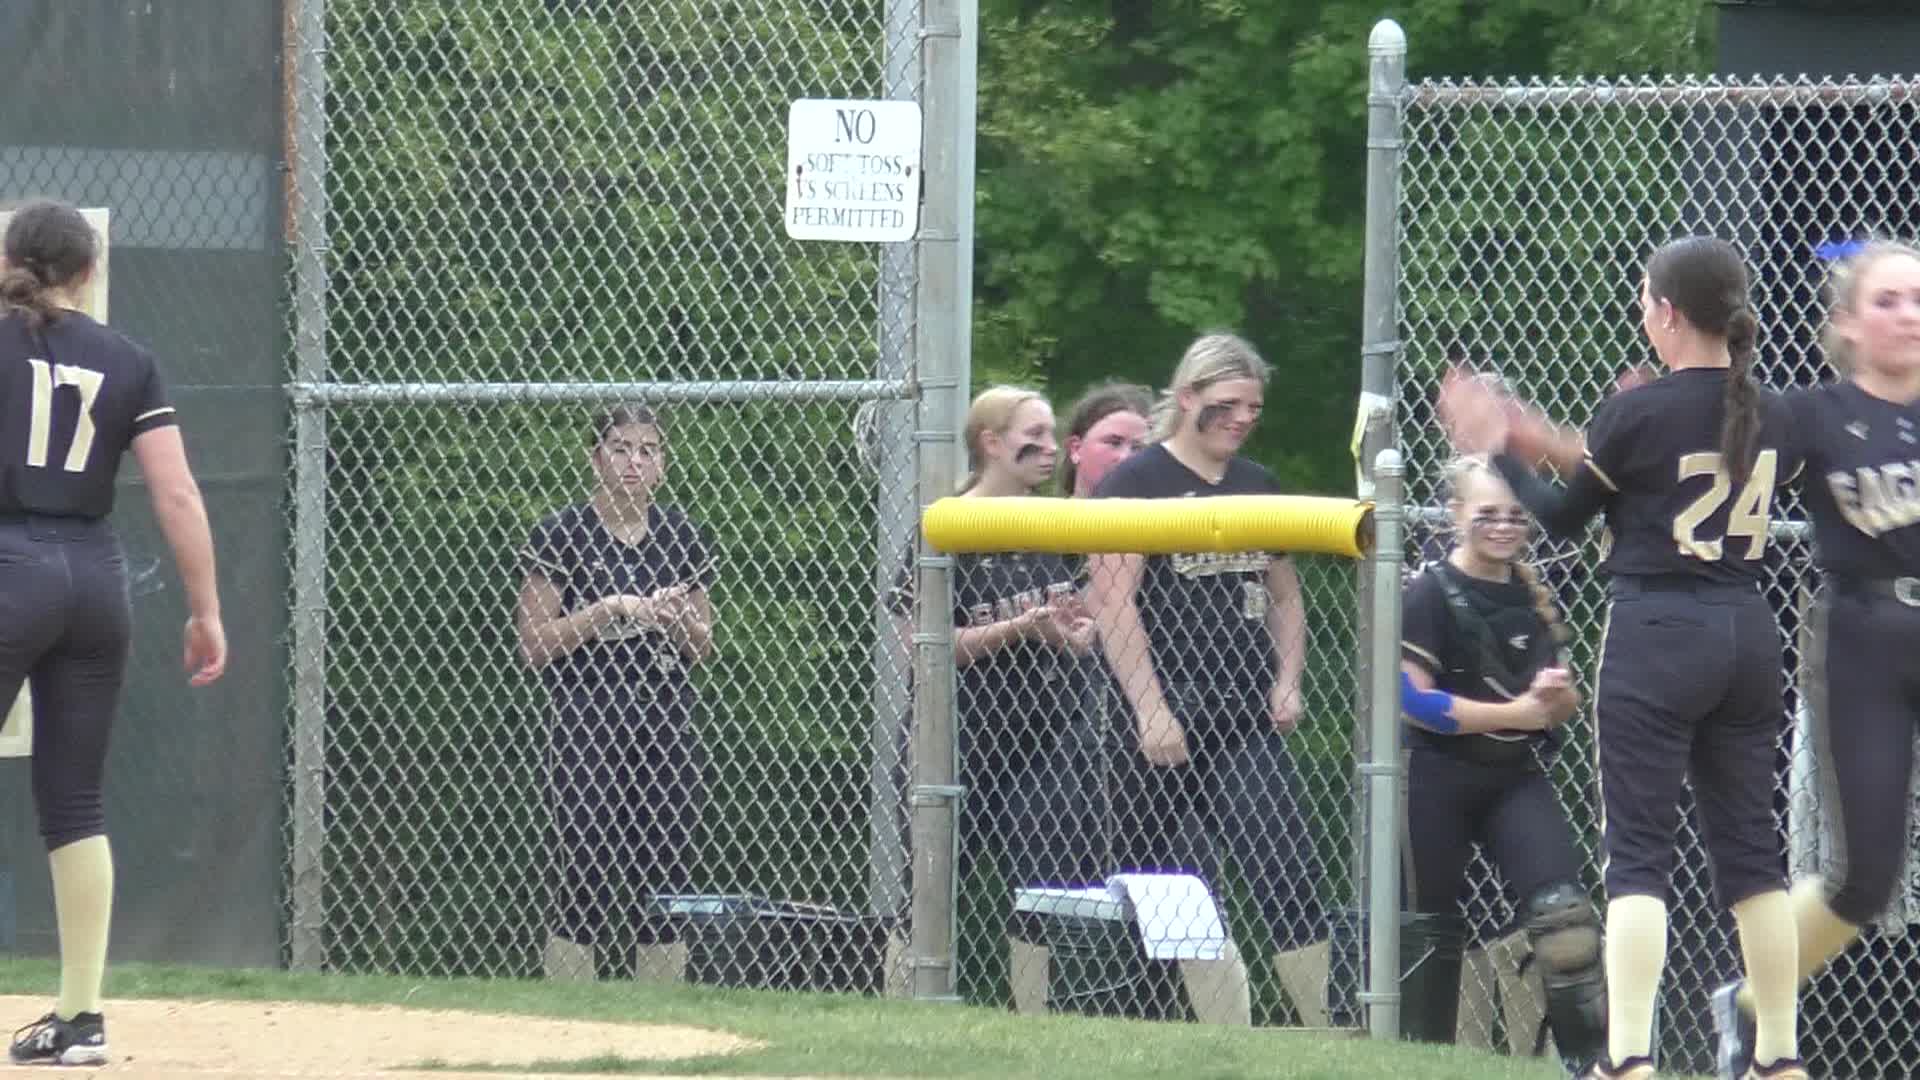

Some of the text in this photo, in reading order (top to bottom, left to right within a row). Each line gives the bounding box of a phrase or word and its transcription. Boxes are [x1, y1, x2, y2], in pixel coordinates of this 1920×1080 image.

[834, 108, 876, 144] NO
[855, 154, 903, 176] TOSS
[792, 206, 904, 229] PERMITTED
[26, 358, 105, 473] 17
[1672, 449, 1778, 562] 24
